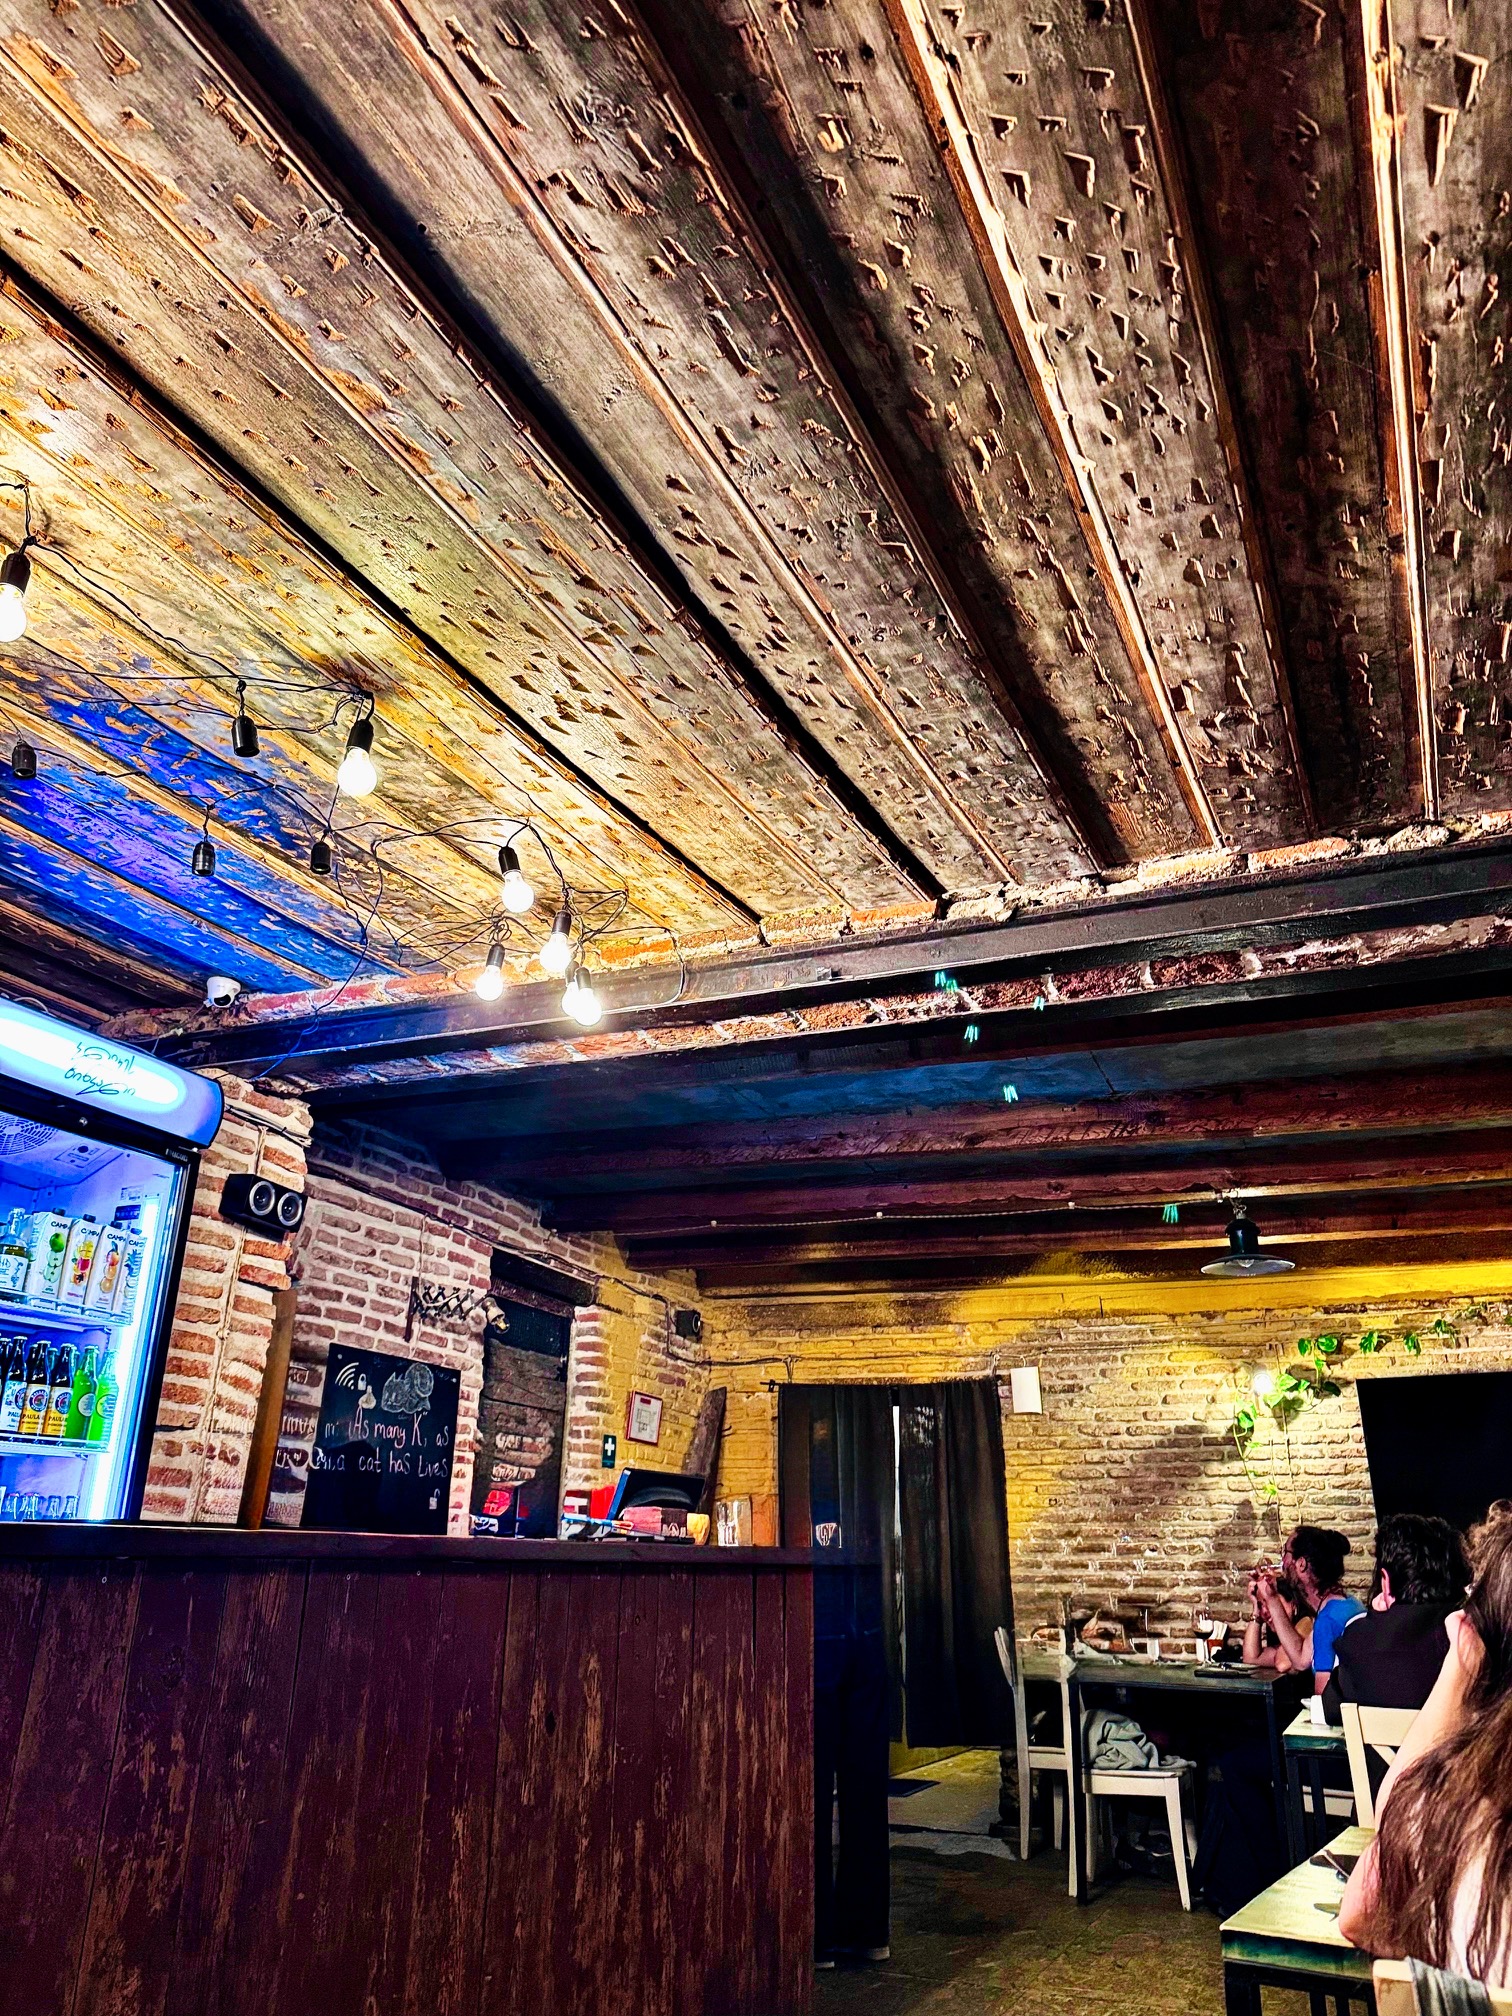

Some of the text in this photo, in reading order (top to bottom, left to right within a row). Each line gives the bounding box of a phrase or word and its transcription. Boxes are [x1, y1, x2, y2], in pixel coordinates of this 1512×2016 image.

[374, 1421, 406, 1449] many
[358, 1446, 382, 1473] cat
[389, 1450, 411, 1475] has
